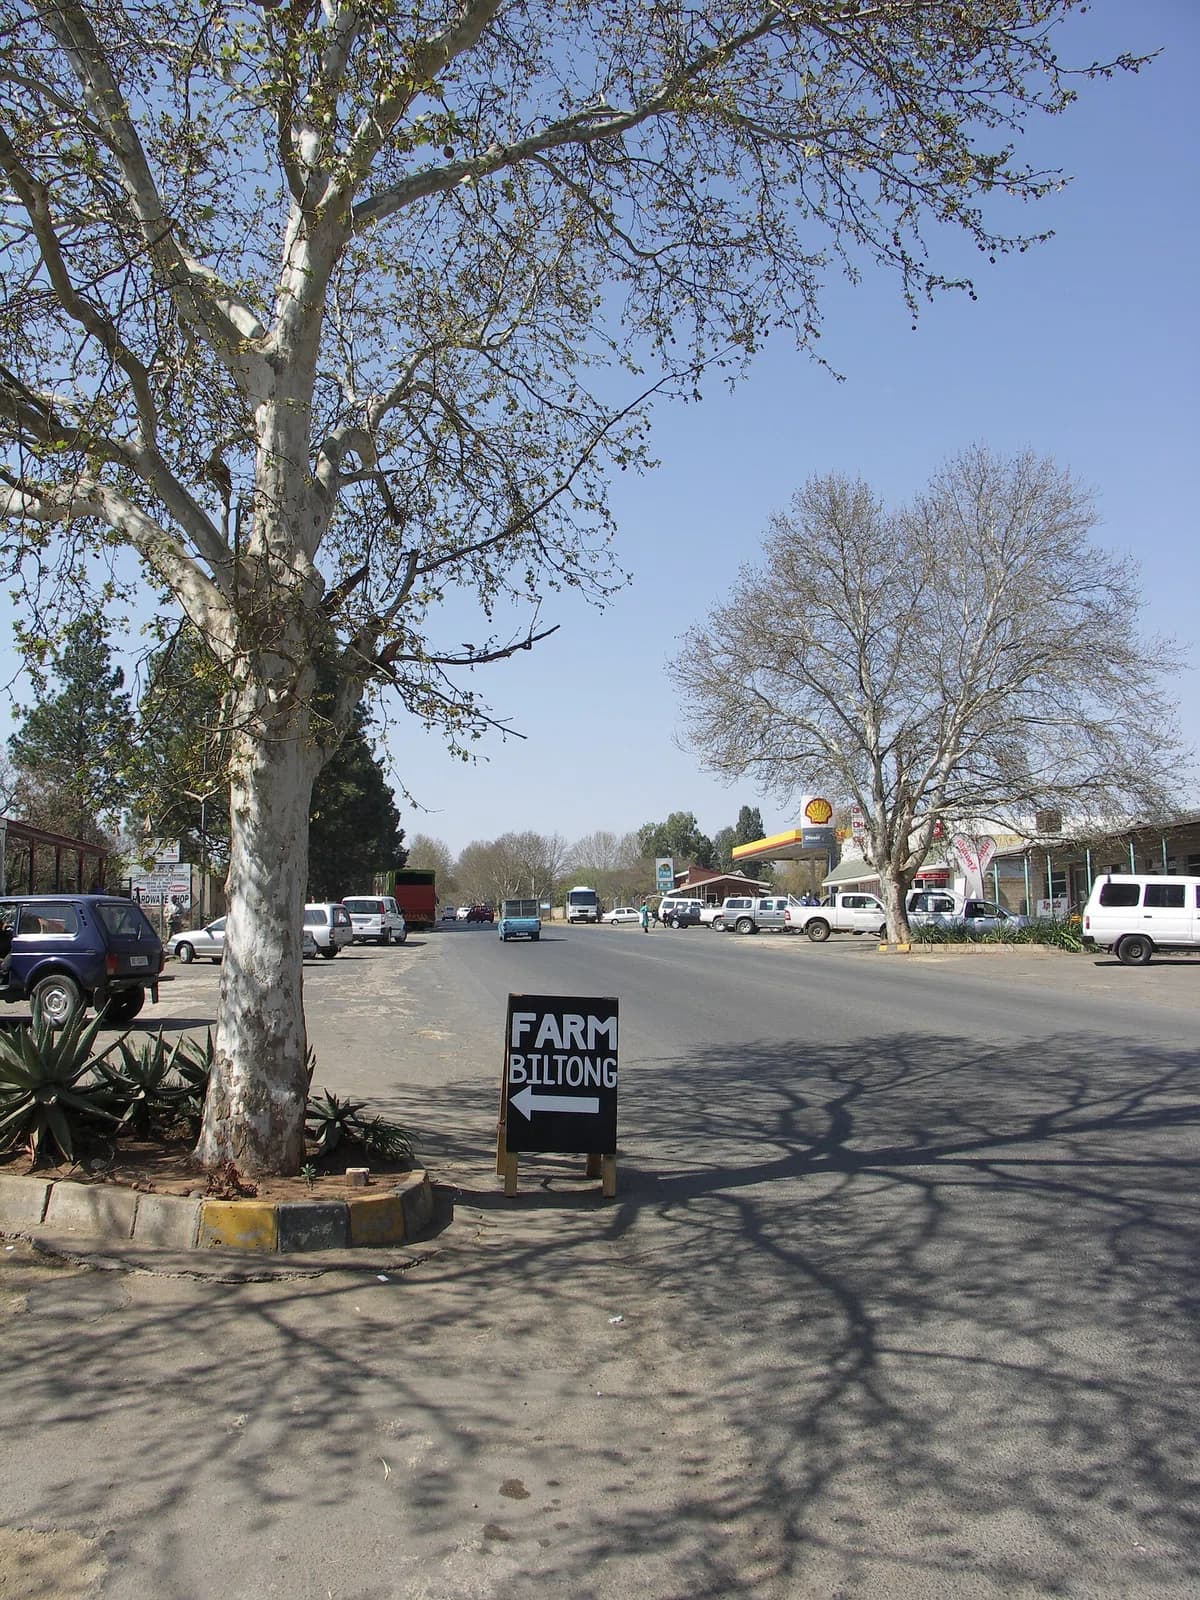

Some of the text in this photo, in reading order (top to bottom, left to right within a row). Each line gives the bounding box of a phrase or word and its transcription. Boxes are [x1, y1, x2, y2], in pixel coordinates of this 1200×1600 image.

[132, 895, 189, 904] HRDWAE HOP
[511, 1012, 617, 1050] FARM
[509, 1054, 618, 1089] BILTONG
